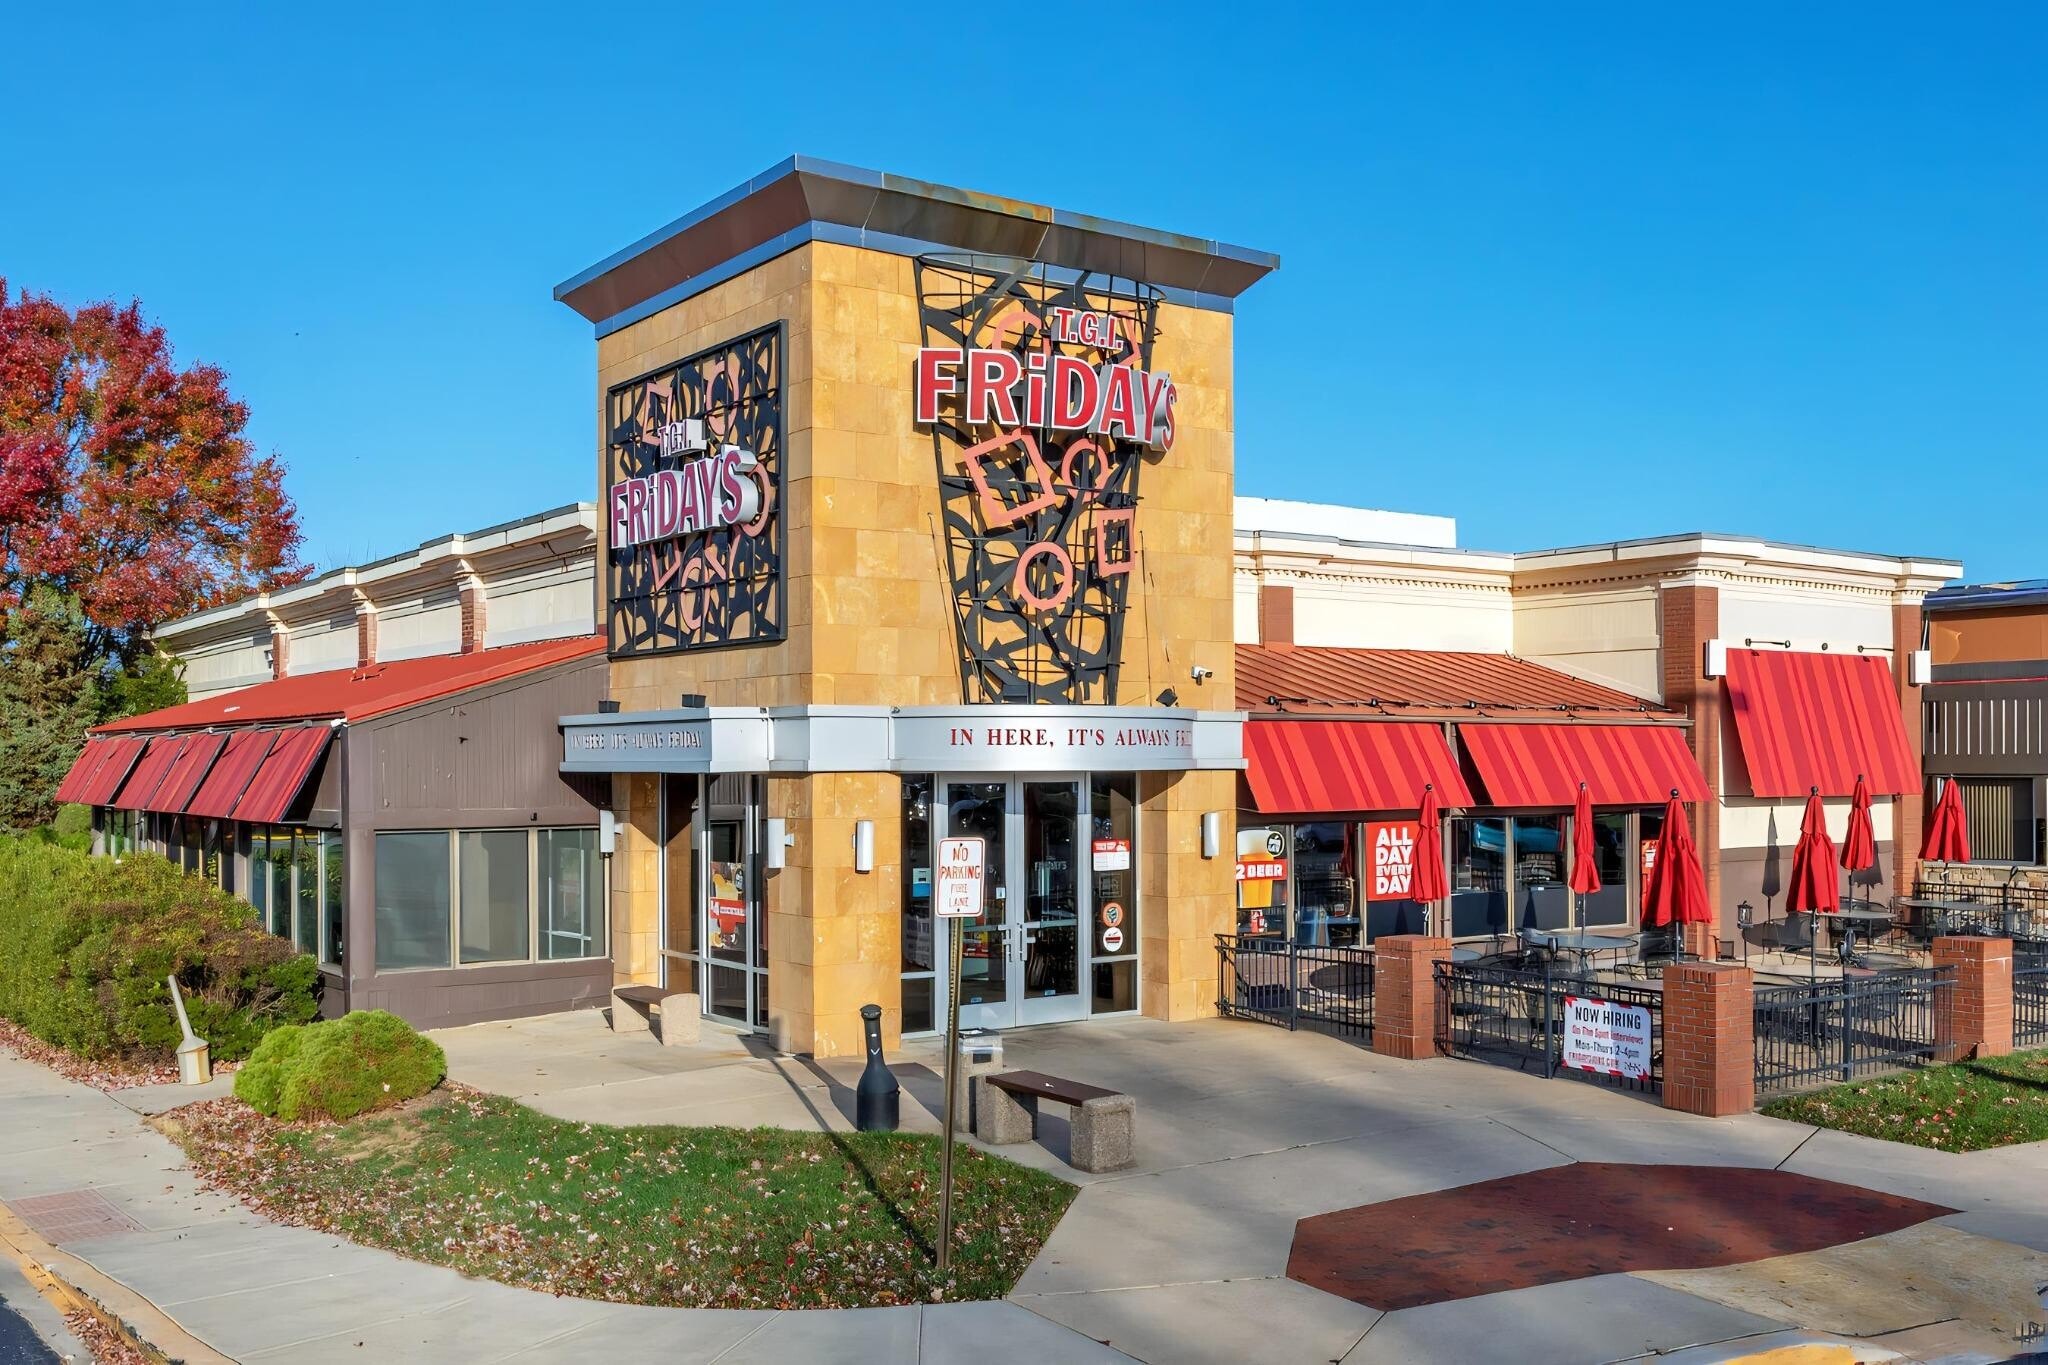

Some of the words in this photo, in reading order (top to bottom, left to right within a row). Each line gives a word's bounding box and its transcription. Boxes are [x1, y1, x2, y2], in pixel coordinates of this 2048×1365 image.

[1053, 307, 1125, 350] T.G.I.
[950, 728, 973, 746] IN
[986, 728, 1054, 748] HERE,
[1067, 728, 1105, 746] IT'S
[1114, 729, 1169, 747] ALWAYS
[1376, 827, 1413, 846] ALL
[953, 847, 969, 862] NO
[1376, 845, 1413, 866] DAY
[940, 865, 981, 880] PARKING
[1247, 863, 1283, 878] BEER
[1376, 863, 1412, 877] EVERY
[1376, 875, 1412, 895] DAY
[1575, 1006, 1599, 1023] NOW
[1603, 1010, 1641, 1030] HIRING
